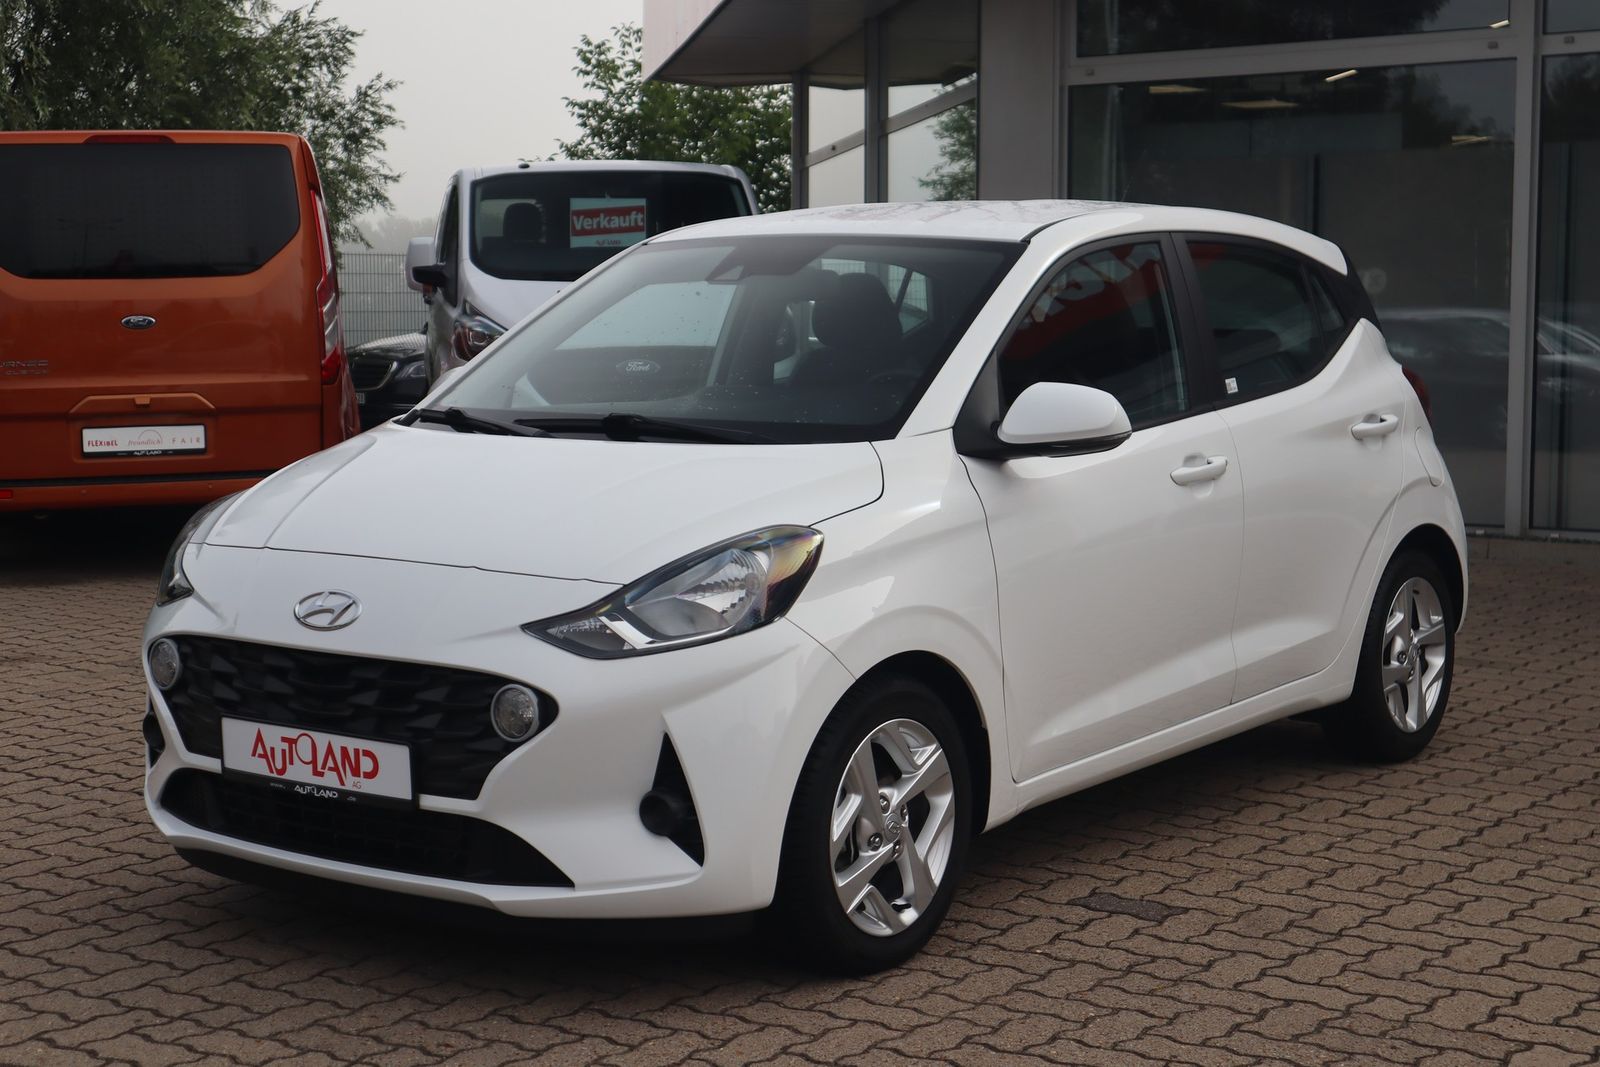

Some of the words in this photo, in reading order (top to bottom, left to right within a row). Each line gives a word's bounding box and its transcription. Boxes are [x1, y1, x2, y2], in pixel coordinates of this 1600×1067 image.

[573, 211, 644, 230] Verkauft
[625, 361, 650, 371] Ford
[87, 440, 119, 448] FLEXIBEL
[127, 438, 161, 446] freundlich
[251, 727, 380, 787] AUTOLAND
[352, 780, 362, 790] AG
[294, 784, 339, 799] AUTOLAND
